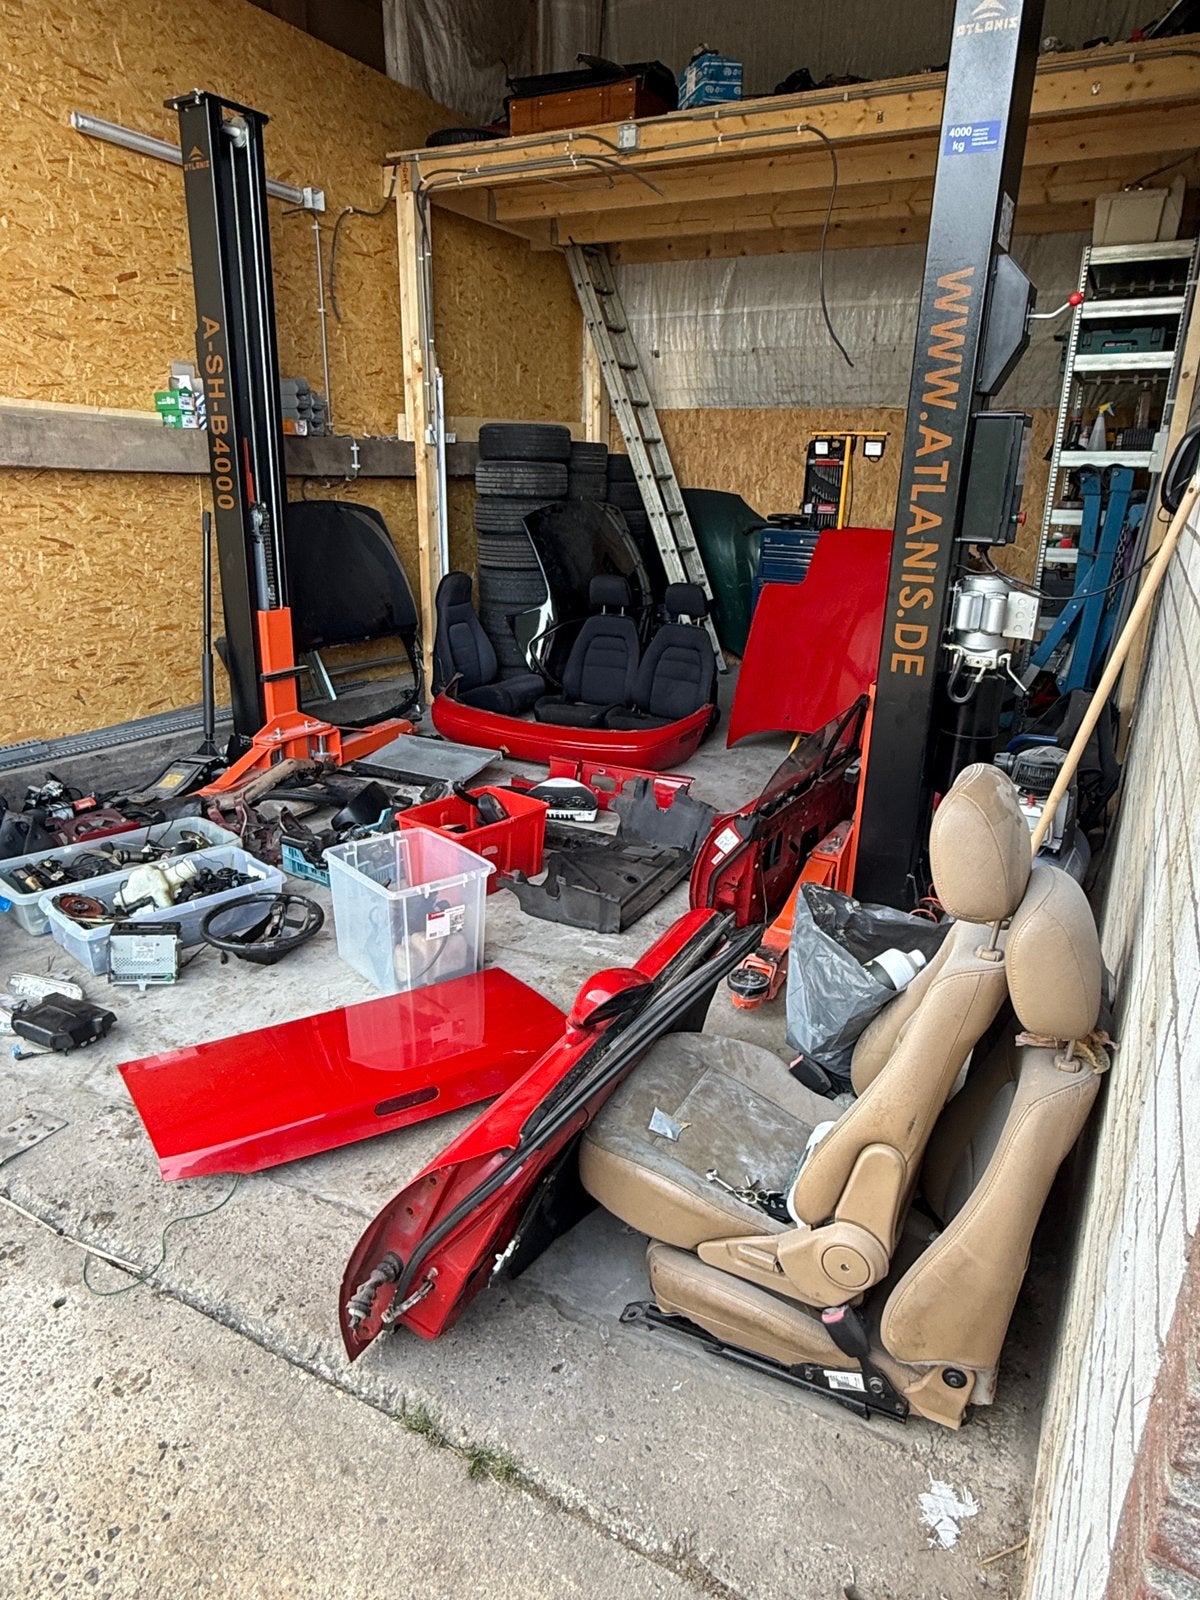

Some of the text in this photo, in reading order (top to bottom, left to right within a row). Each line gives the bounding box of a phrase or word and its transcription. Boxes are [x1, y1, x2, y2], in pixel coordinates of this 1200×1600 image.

[949, 126, 972, 138] 4000
[952, 141, 965, 153] kg
[202, 315, 235, 511] A-SH-B4000
[890, 267, 975, 678] WWW.ATLANIS.DE
